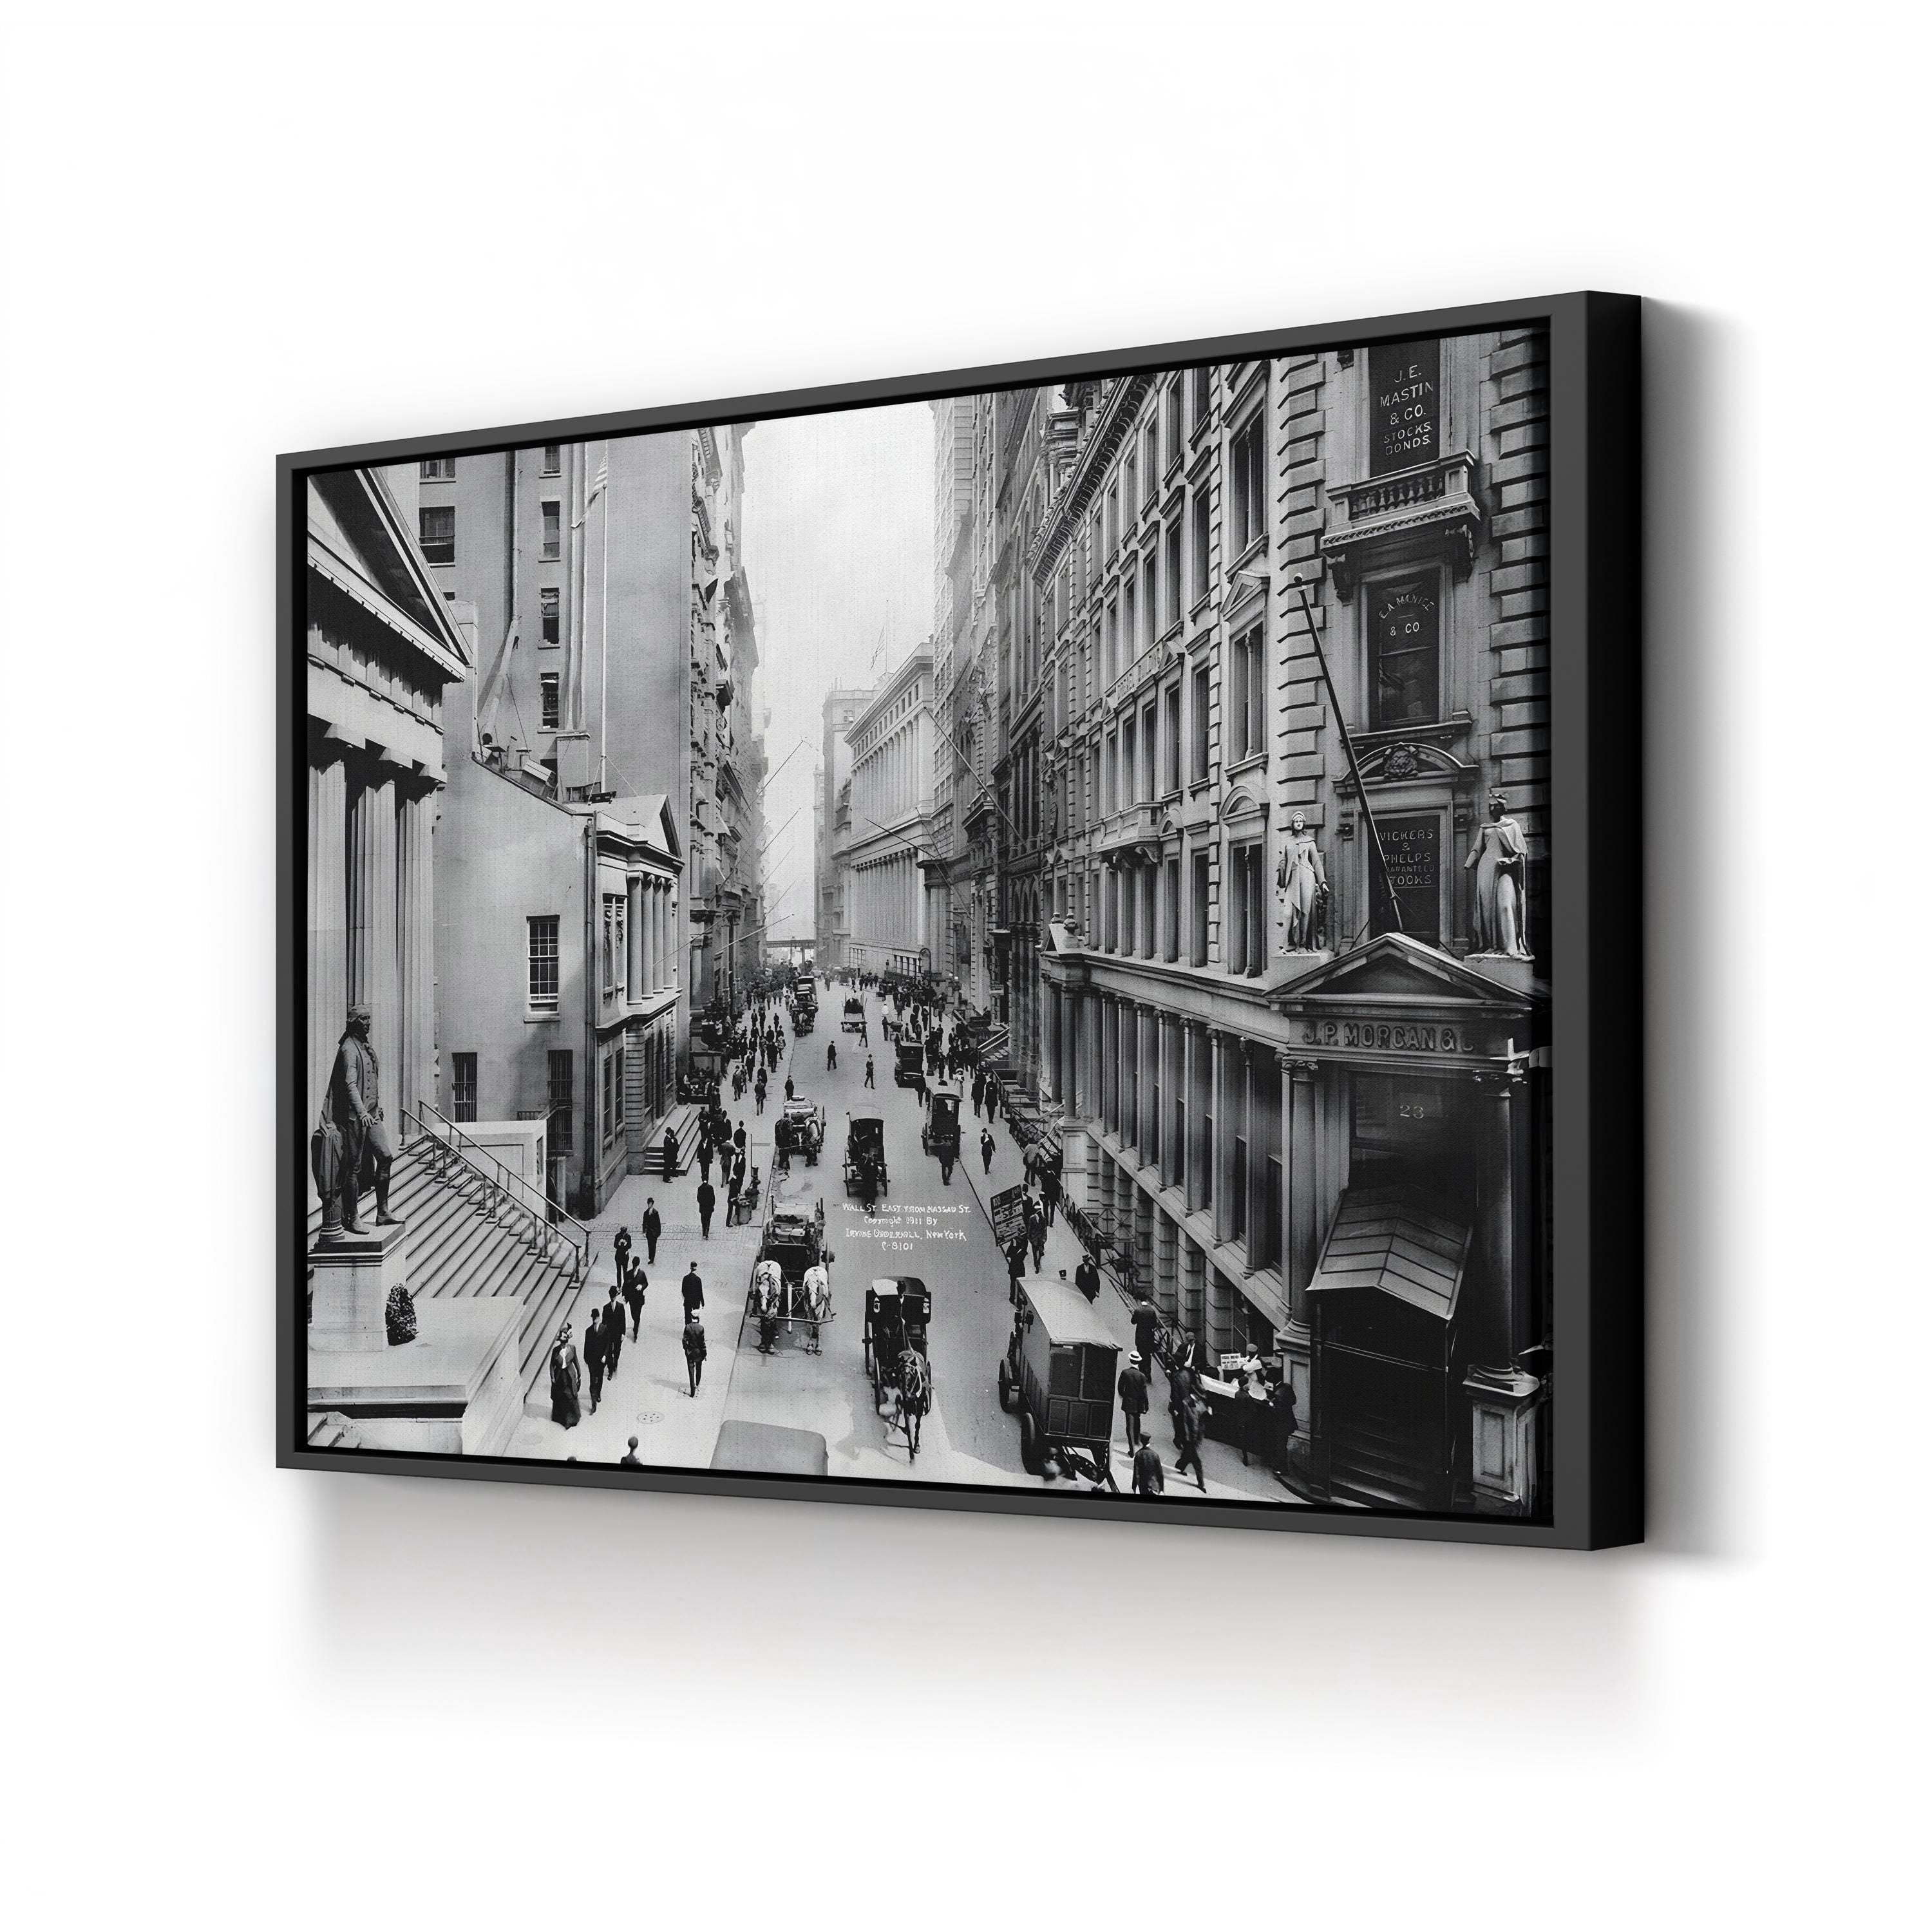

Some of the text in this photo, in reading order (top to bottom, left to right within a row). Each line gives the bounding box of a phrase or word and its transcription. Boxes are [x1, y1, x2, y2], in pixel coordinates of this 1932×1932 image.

[1379, 381, 1434, 407] MASTIN
[1390, 413, 1399, 425] &
[1399, 1104, 1425, 1119] 23
